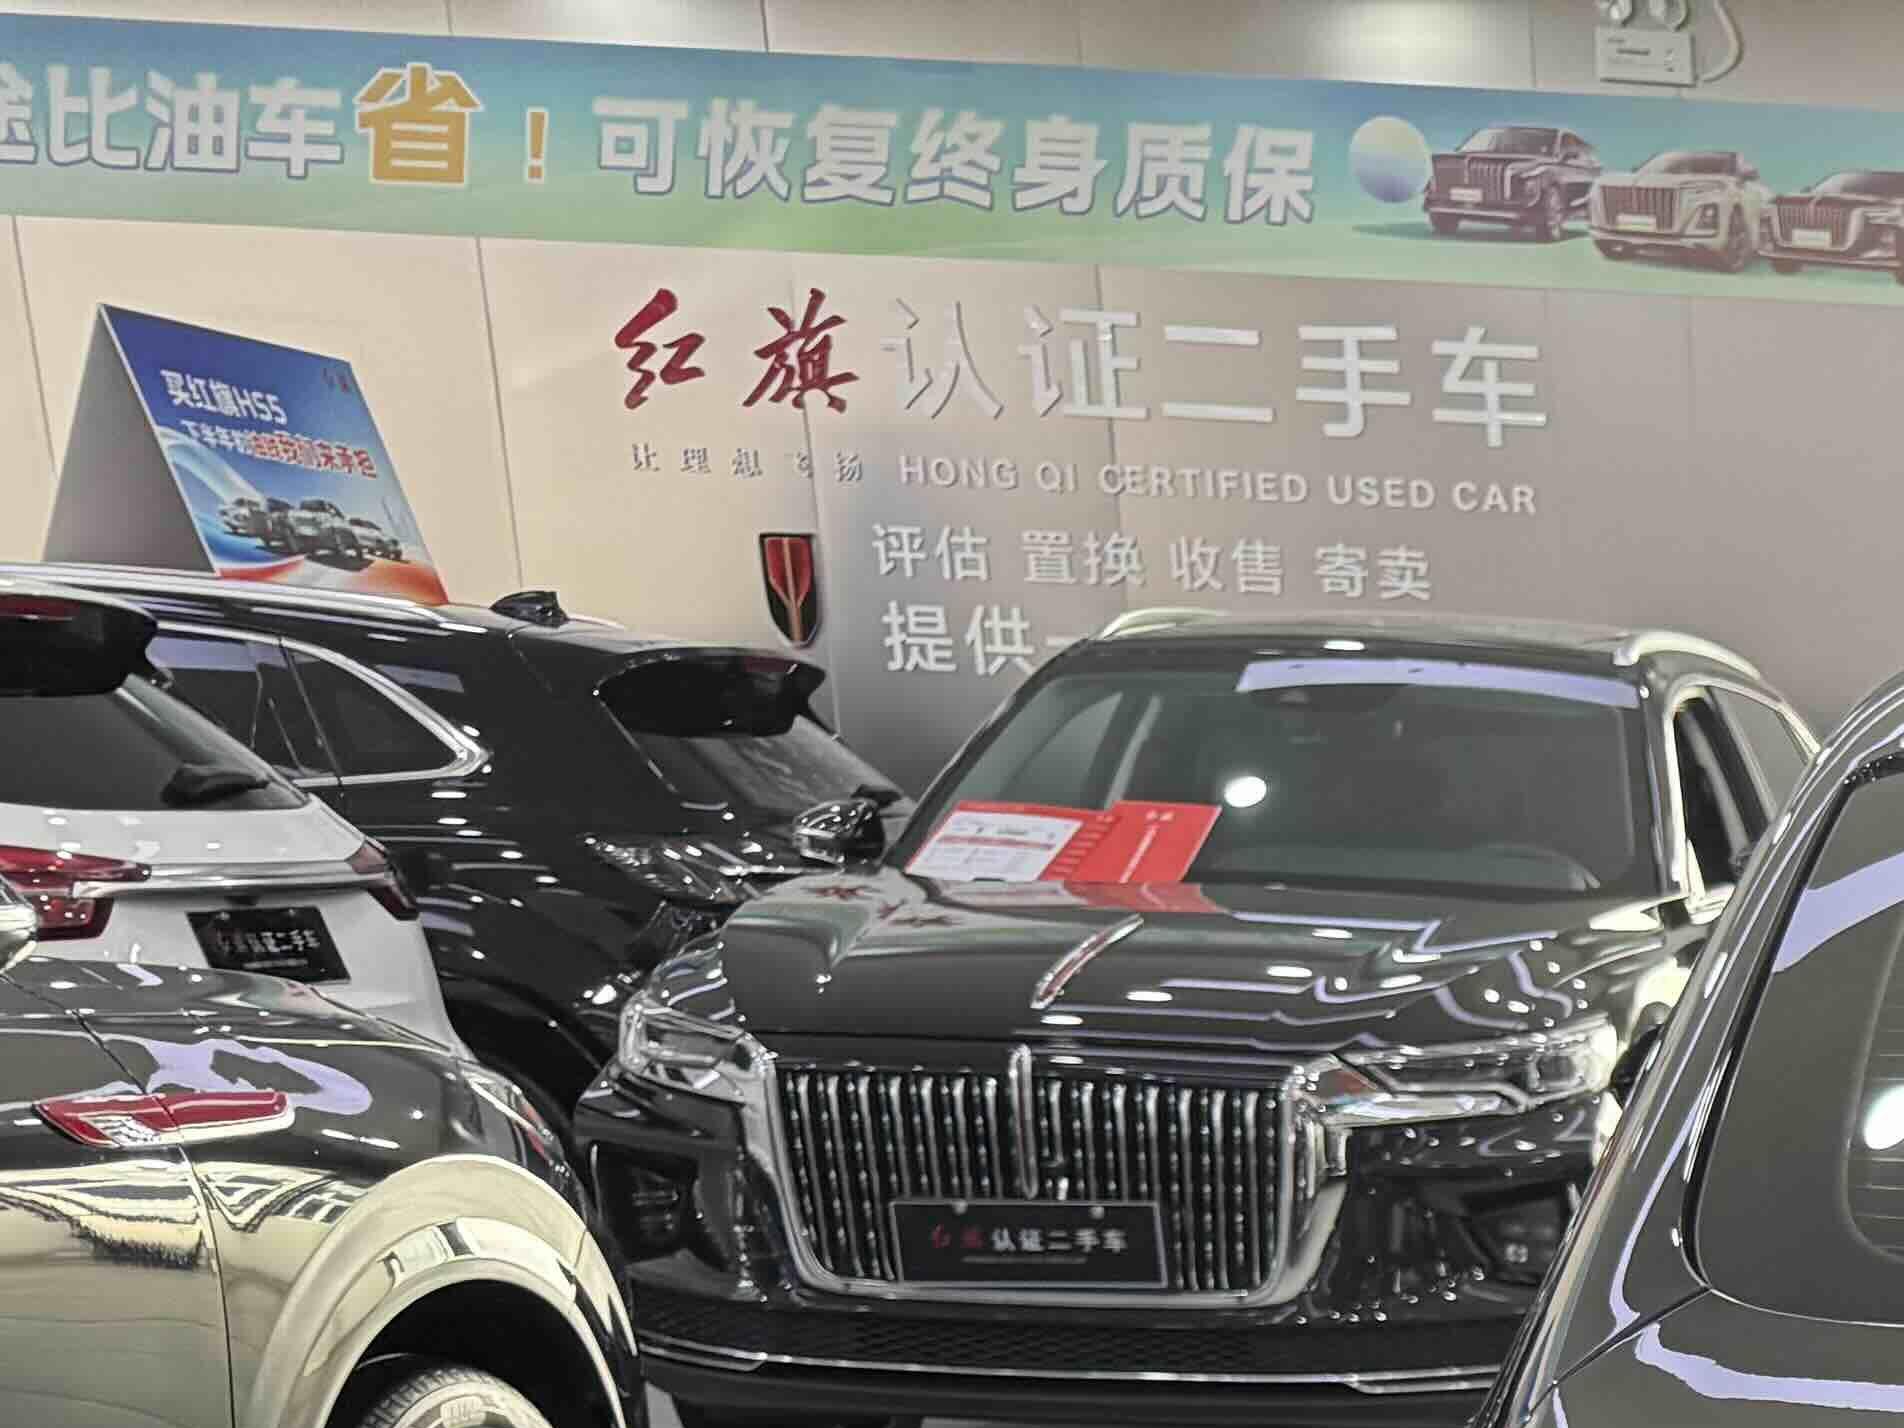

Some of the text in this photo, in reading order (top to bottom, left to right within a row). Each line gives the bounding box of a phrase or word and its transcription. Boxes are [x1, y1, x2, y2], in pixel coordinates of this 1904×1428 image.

[899, 455, 1538, 515] HONG QI CERTIFIED USED CAR
[872, 524, 1433, 600] 评估 置换 收售 寄卖
